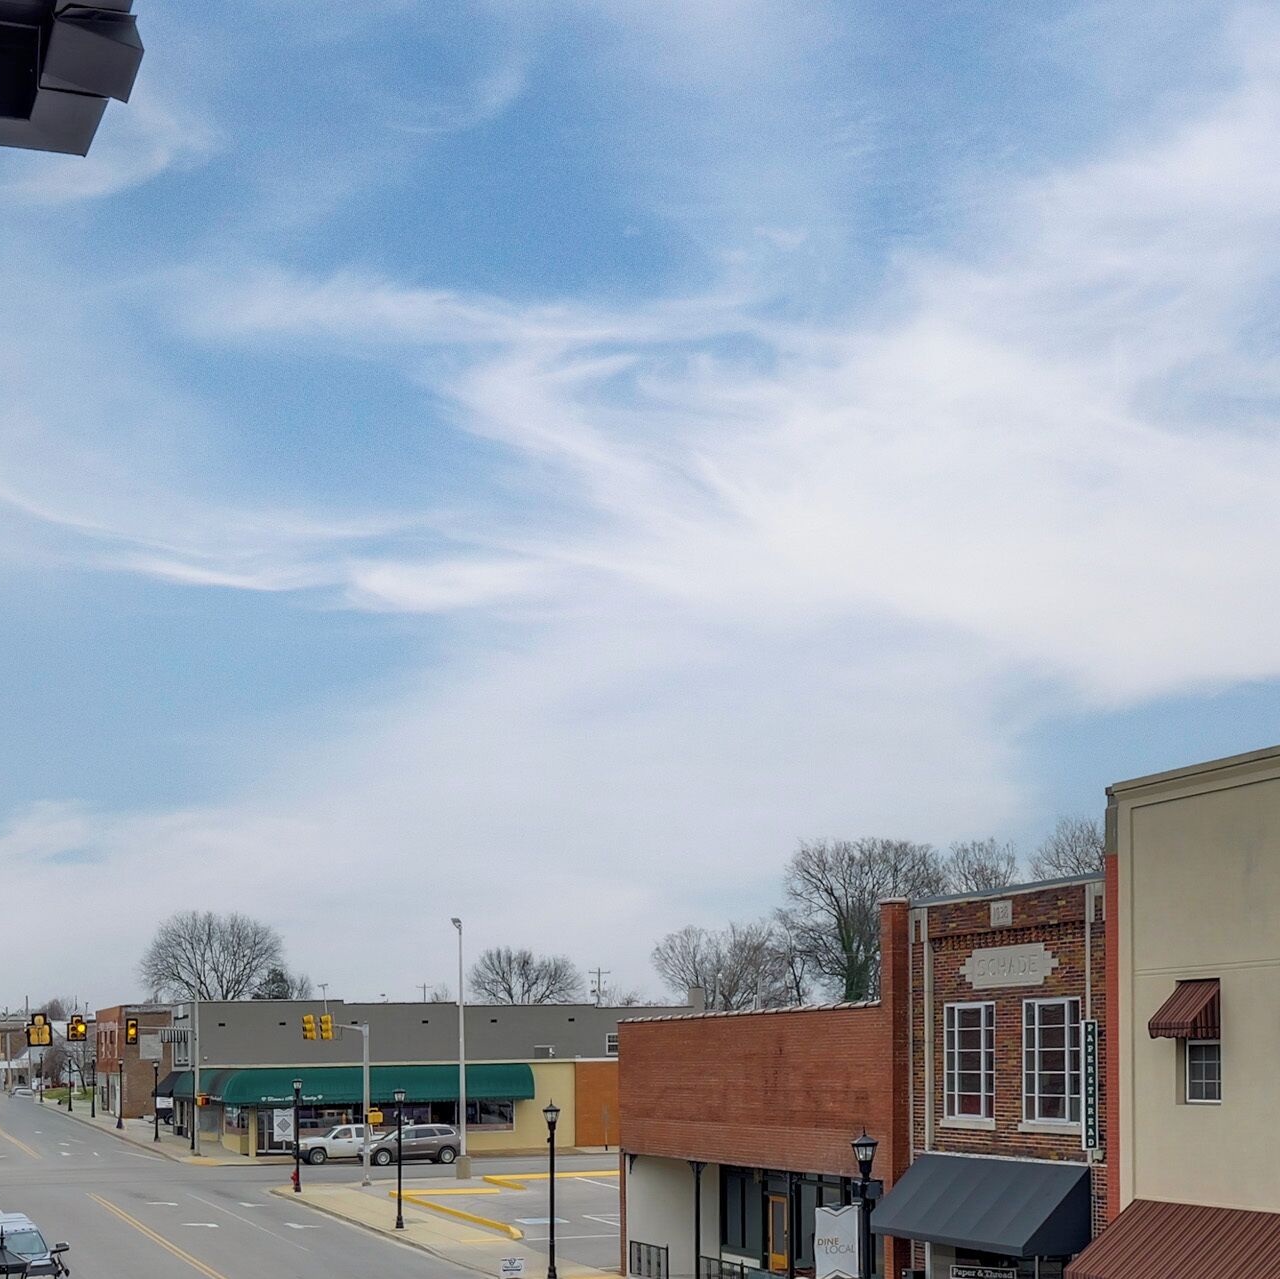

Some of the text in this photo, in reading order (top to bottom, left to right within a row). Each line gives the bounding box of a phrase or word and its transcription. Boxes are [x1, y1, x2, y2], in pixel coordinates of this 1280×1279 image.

[976, 953, 1038, 977] SCHADE
[817, 1238, 839, 1246] DINE
[825, 1245, 856, 1255] LOCAL
[953, 1267, 1014, 1279] Paper & Thread
